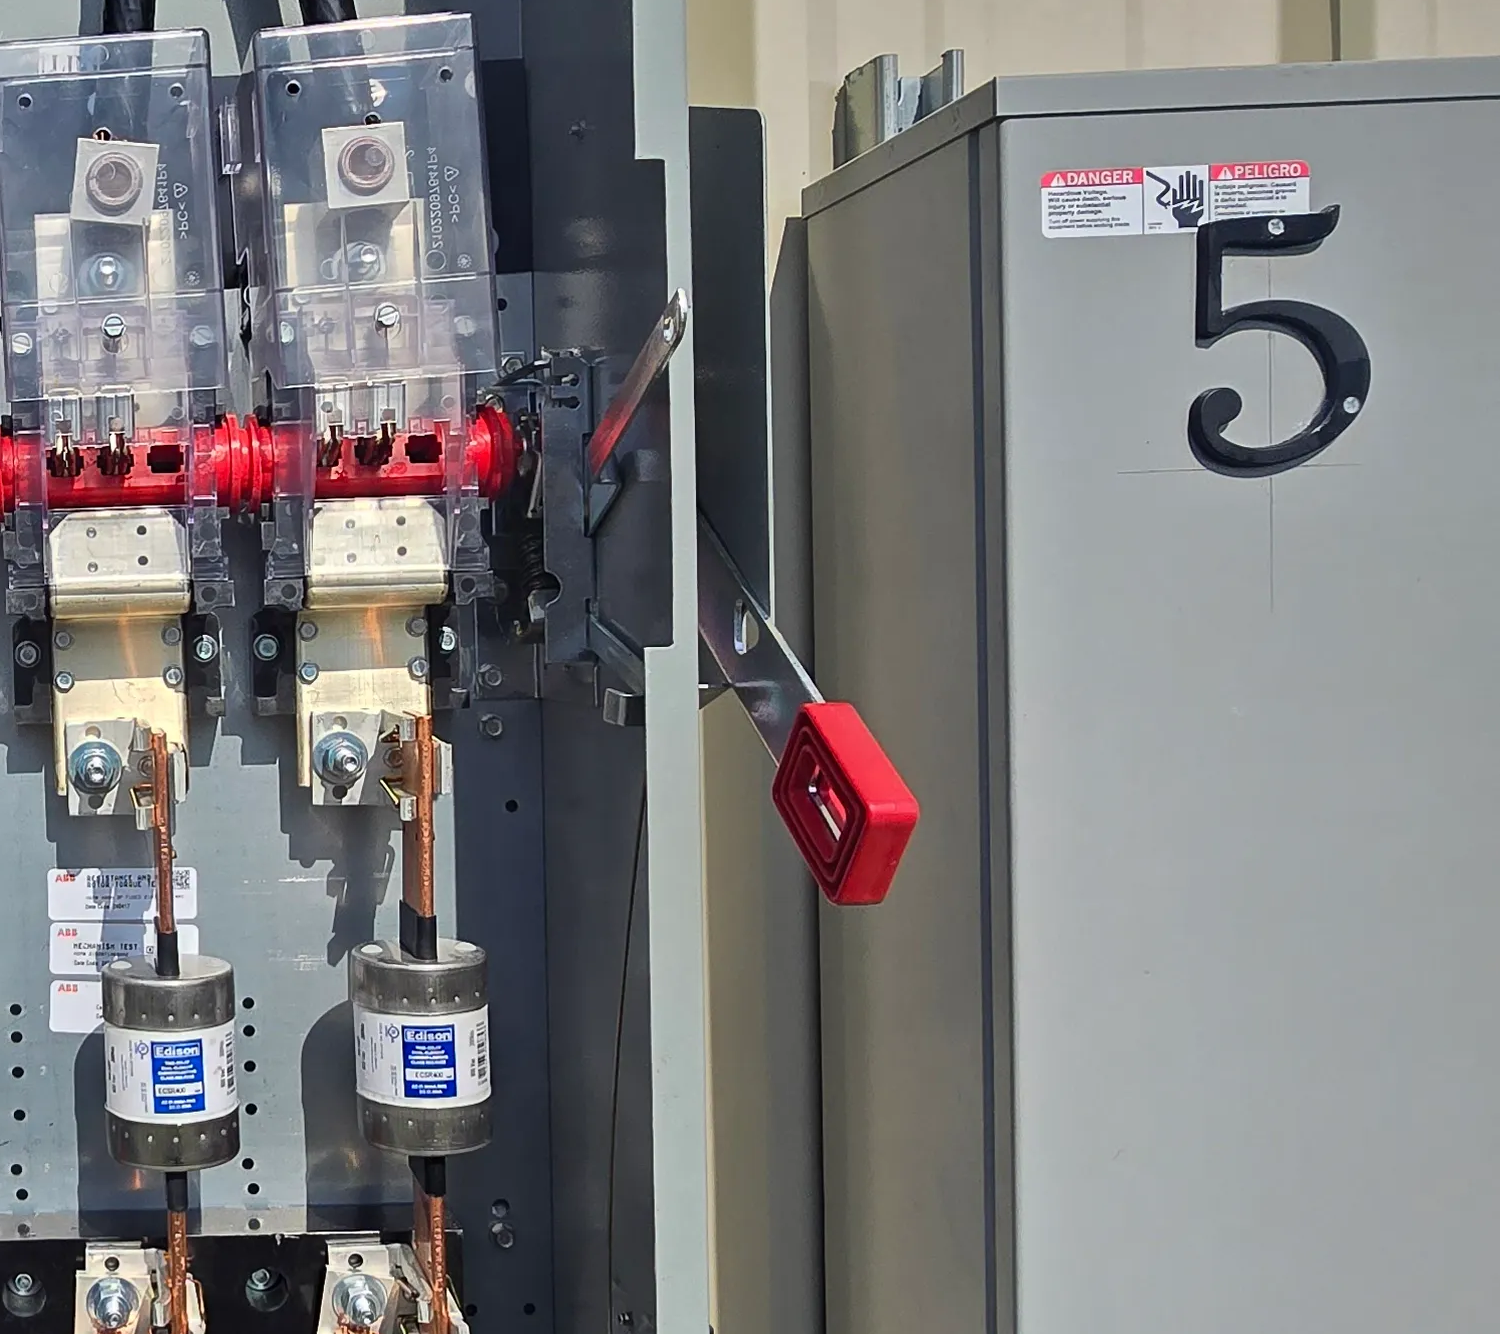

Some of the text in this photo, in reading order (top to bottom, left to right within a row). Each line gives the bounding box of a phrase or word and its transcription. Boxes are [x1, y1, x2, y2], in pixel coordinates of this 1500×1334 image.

[1234, 163, 1301, 179] PELIGRO
[1066, 170, 1133, 186] DANGER
[1187, 204, 1372, 479] 5
[55, 873, 76, 883] ABB
[57, 928, 78, 937] ABB
[120, 943, 139, 951] TEST
[57, 984, 79, 993] ABB
[406, 1028, 452, 1042] Edison
[155, 1044, 200, 1057] Edison
